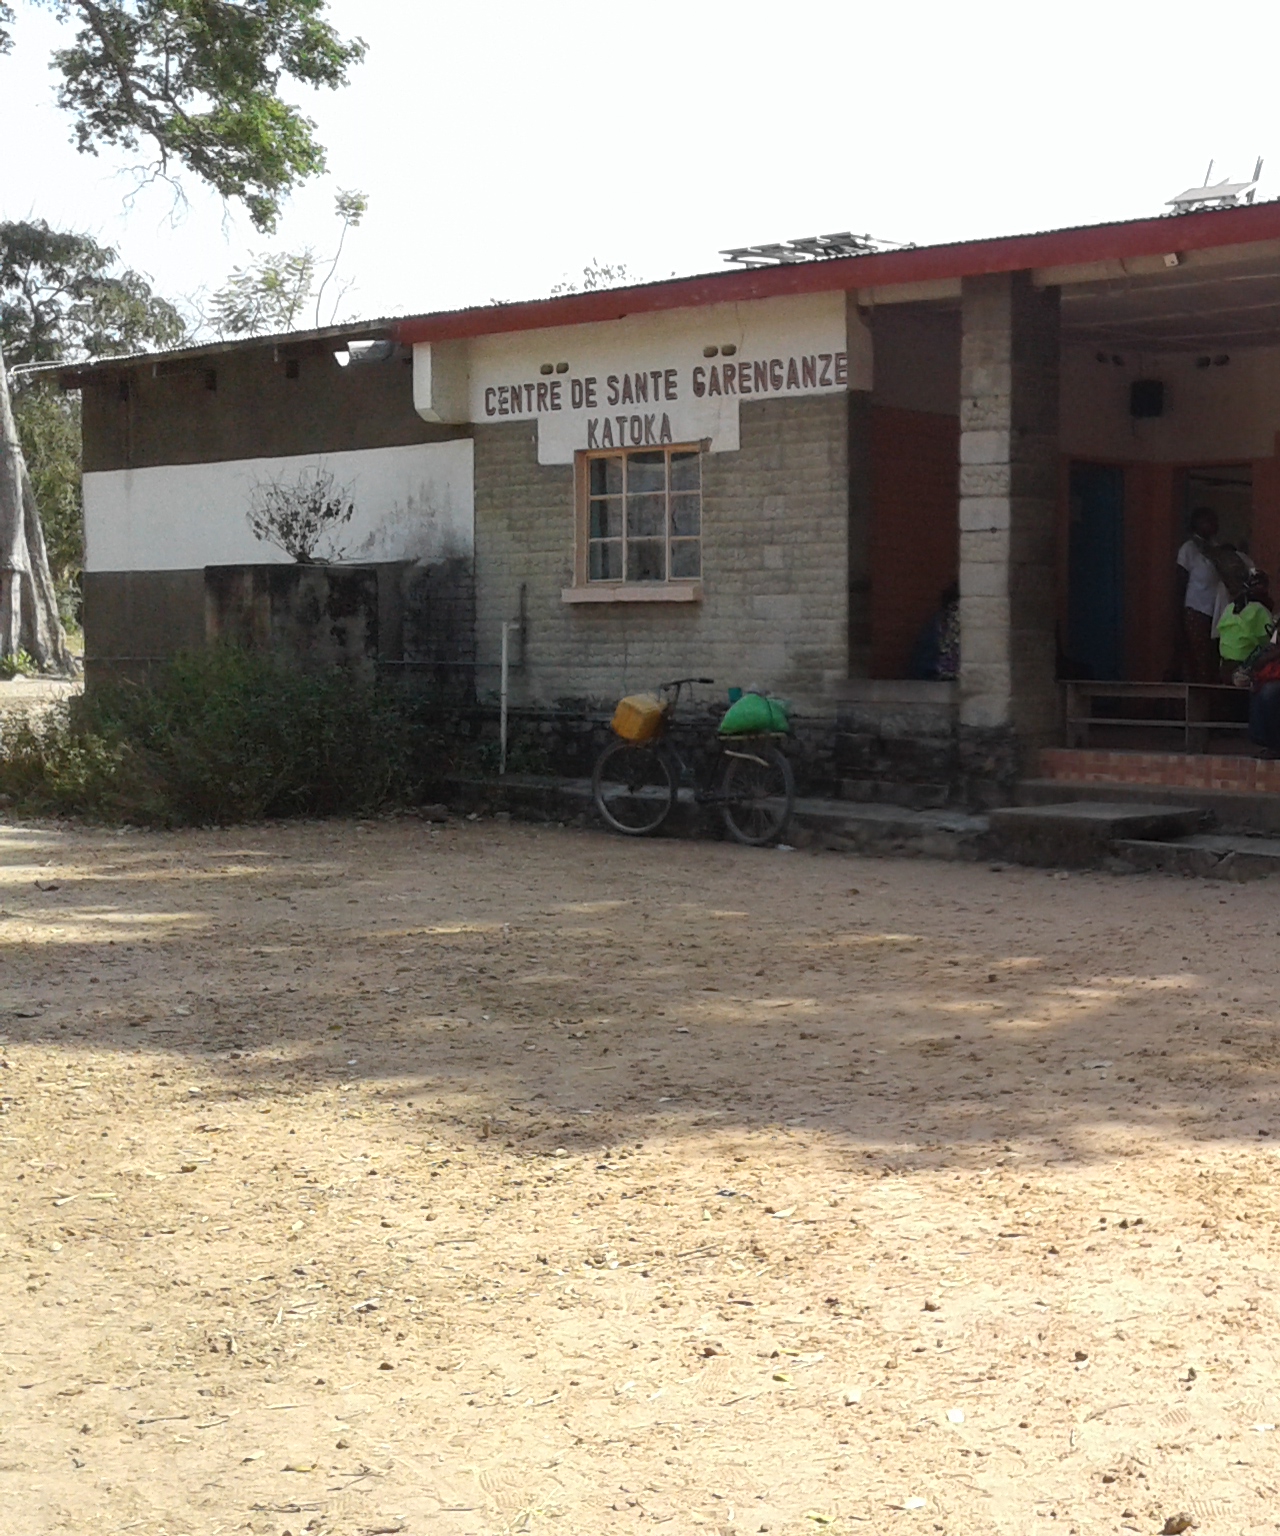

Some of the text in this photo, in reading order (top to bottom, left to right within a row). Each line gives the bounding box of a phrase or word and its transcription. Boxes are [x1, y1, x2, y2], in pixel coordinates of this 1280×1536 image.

[485, 351, 848, 416] CENTRE DE SANTE GARENGANZE
[587, 412, 672, 449] KATOKA
